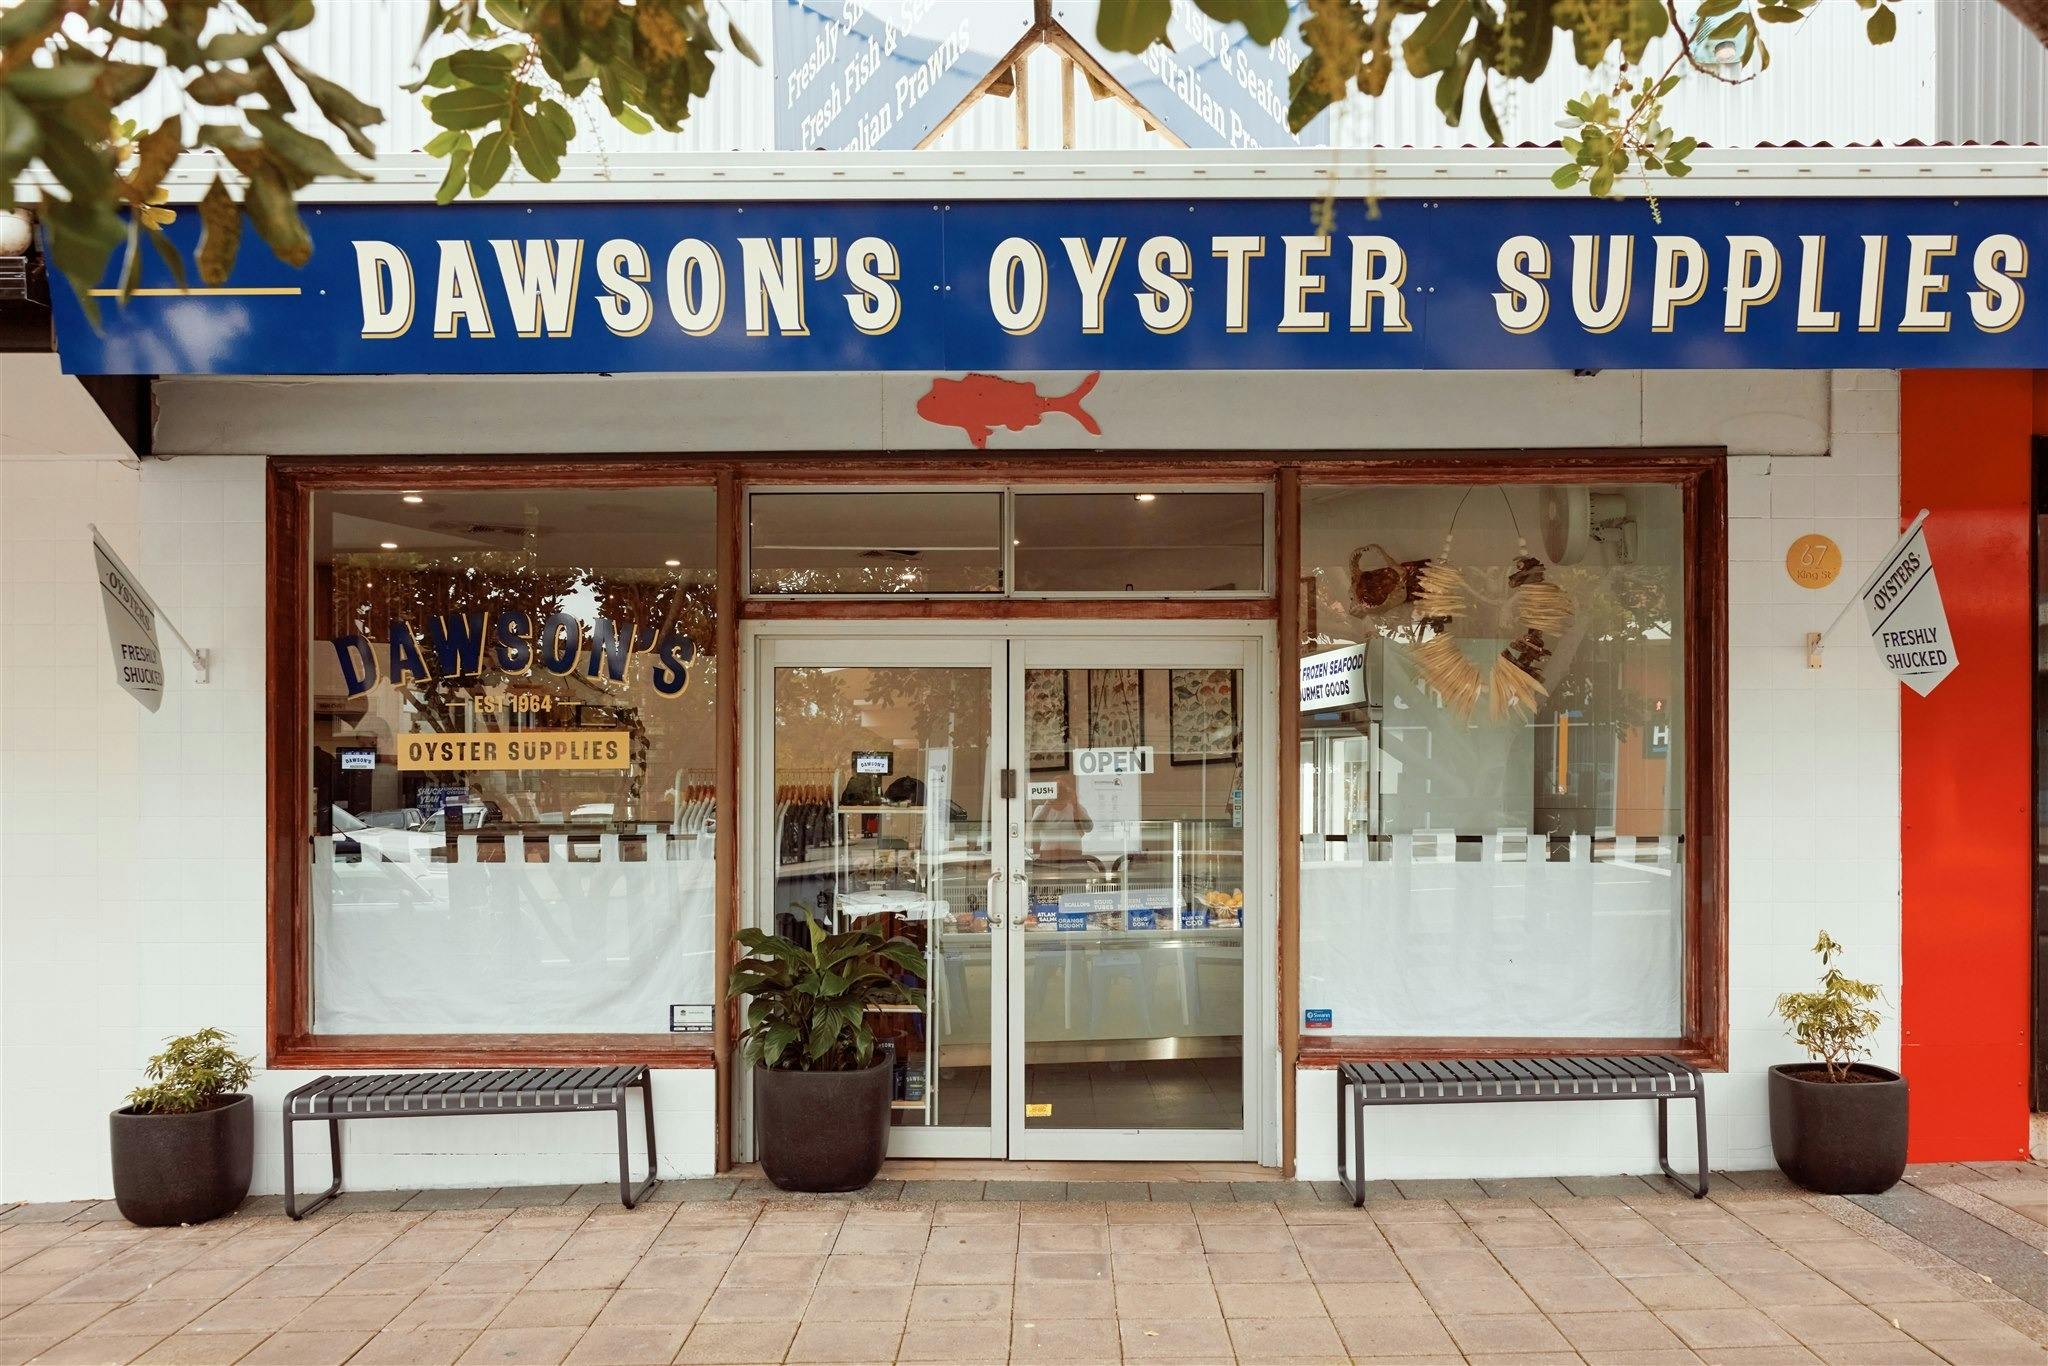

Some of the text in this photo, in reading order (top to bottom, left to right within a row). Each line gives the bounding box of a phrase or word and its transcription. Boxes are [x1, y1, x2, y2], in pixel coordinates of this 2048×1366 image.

[788, 20, 839, 109] Freshly
[896, 18, 970, 121] Prawns
[801, 82, 841, 150] Fresh
[844, 34, 880, 105] Fish
[885, 16, 897, 56] &
[351, 234, 2028, 338] DAWSON'S OYSTER SUPPLIES
[1801, 543, 1829, 567] 67
[1797, 570, 1832, 580] King St
[1873, 552, 1921, 611] OYSTERS
[109, 571, 151, 632] OYSTERS
[1883, 627, 1938, 648] FRESHLY
[121, 643, 157, 665] FRESHLY
[330, 611, 697, 699] DAWSON'S
[1886, 649, 1947, 669] SHUCKED
[123, 665, 163, 687] SHUCKED
[1302, 653, 1364, 682] FROZEN SEAFOOD
[1300, 679, 1350, 702] URMET GOODS
[511, 694, 552, 713] 1964
[409, 740, 618, 762] OYSTER SUPPLIES
[1079, 750, 1146, 774] OPEN
[1031, 786, 1054, 796] PUSH
